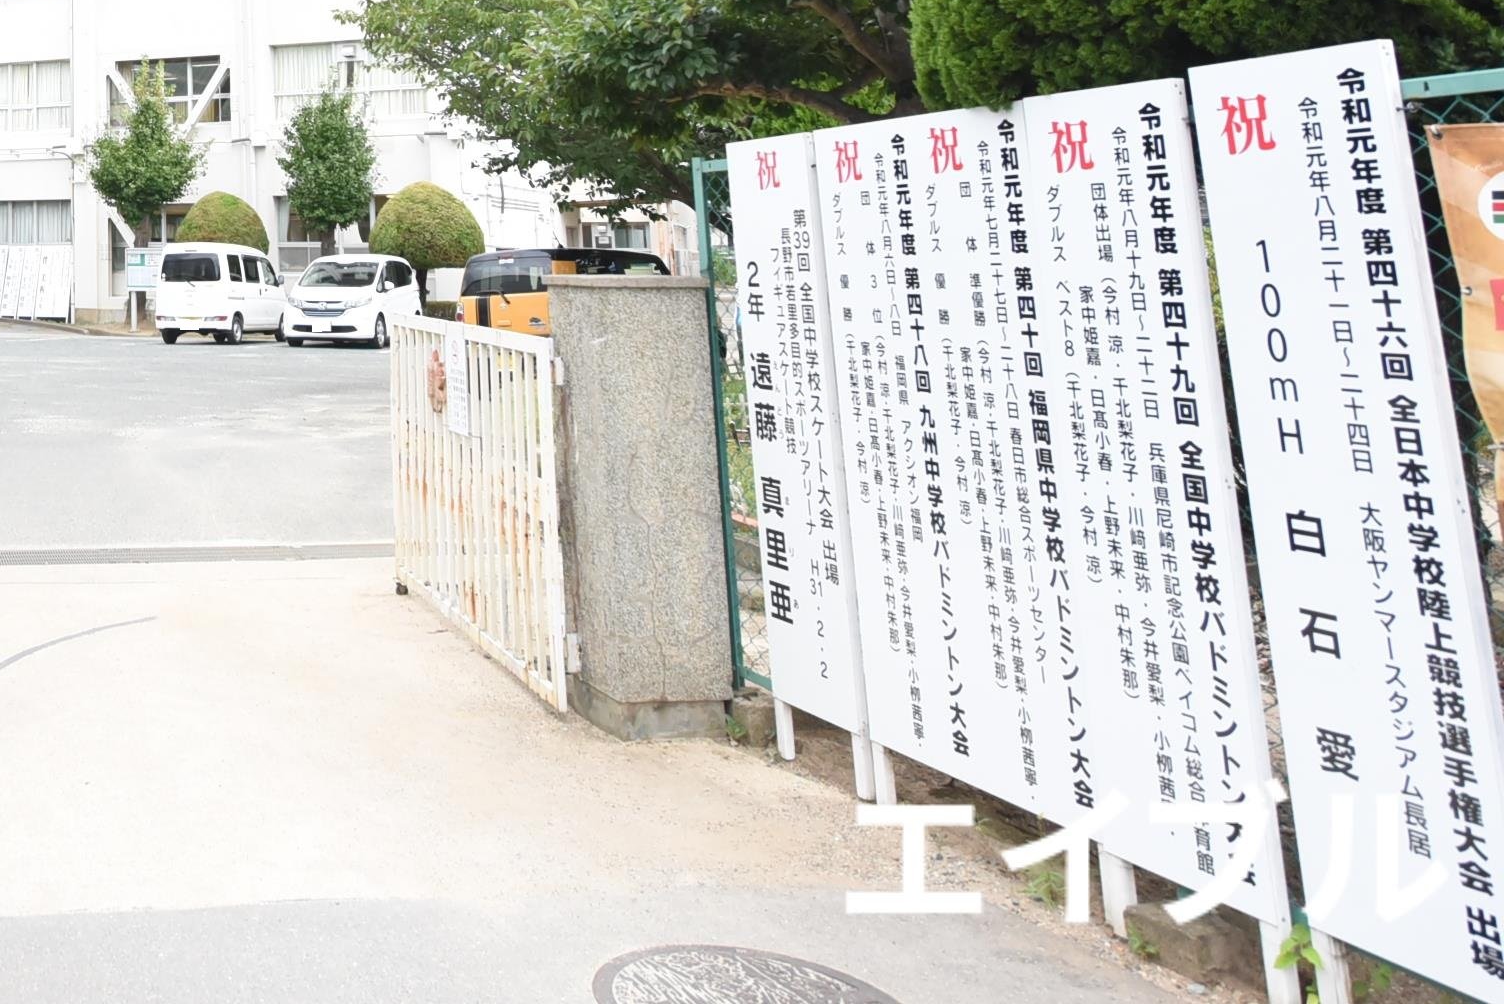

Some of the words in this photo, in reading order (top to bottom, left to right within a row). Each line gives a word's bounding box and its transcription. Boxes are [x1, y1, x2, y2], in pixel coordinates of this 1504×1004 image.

[834, 139, 864, 182] 祝
[929, 126, 965, 175] 祝
[1051, 119, 1096, 175] 祝
[1219, 93, 1278, 157] 祝
[1335, 67, 1388, 215] 令和元年度
[756, 150, 782, 189] 祝
[890, 133, 917, 256] 令和元年度
[1137, 102, 1179, 255] 令和元年度
[832, 194, 846, 255] ダブルス
[925, 183, 942, 253] ダブルス
[996, 118, 1030, 254] 令和元年度
[1013, 266, 1044, 378] 第四十回
[1046, 184, 1067, 262] ダブルス
[1090, 182, 1114, 263] 団体出場
[903, 267, 932, 394] 第四十八回
[1360, 227, 1414, 382] 第四十六回
[1157, 268, 1200, 428] 第四十九回
[822, 539, 840, 586] 出場
[1148, 442, 1216, 877] 兵庫県尼崎市記念公園ベイコム総合育館
[1387, 394, 1495, 897] 全日本中学校陸上競技選手権大会
[1465, 905, 1504, 989] 出場
